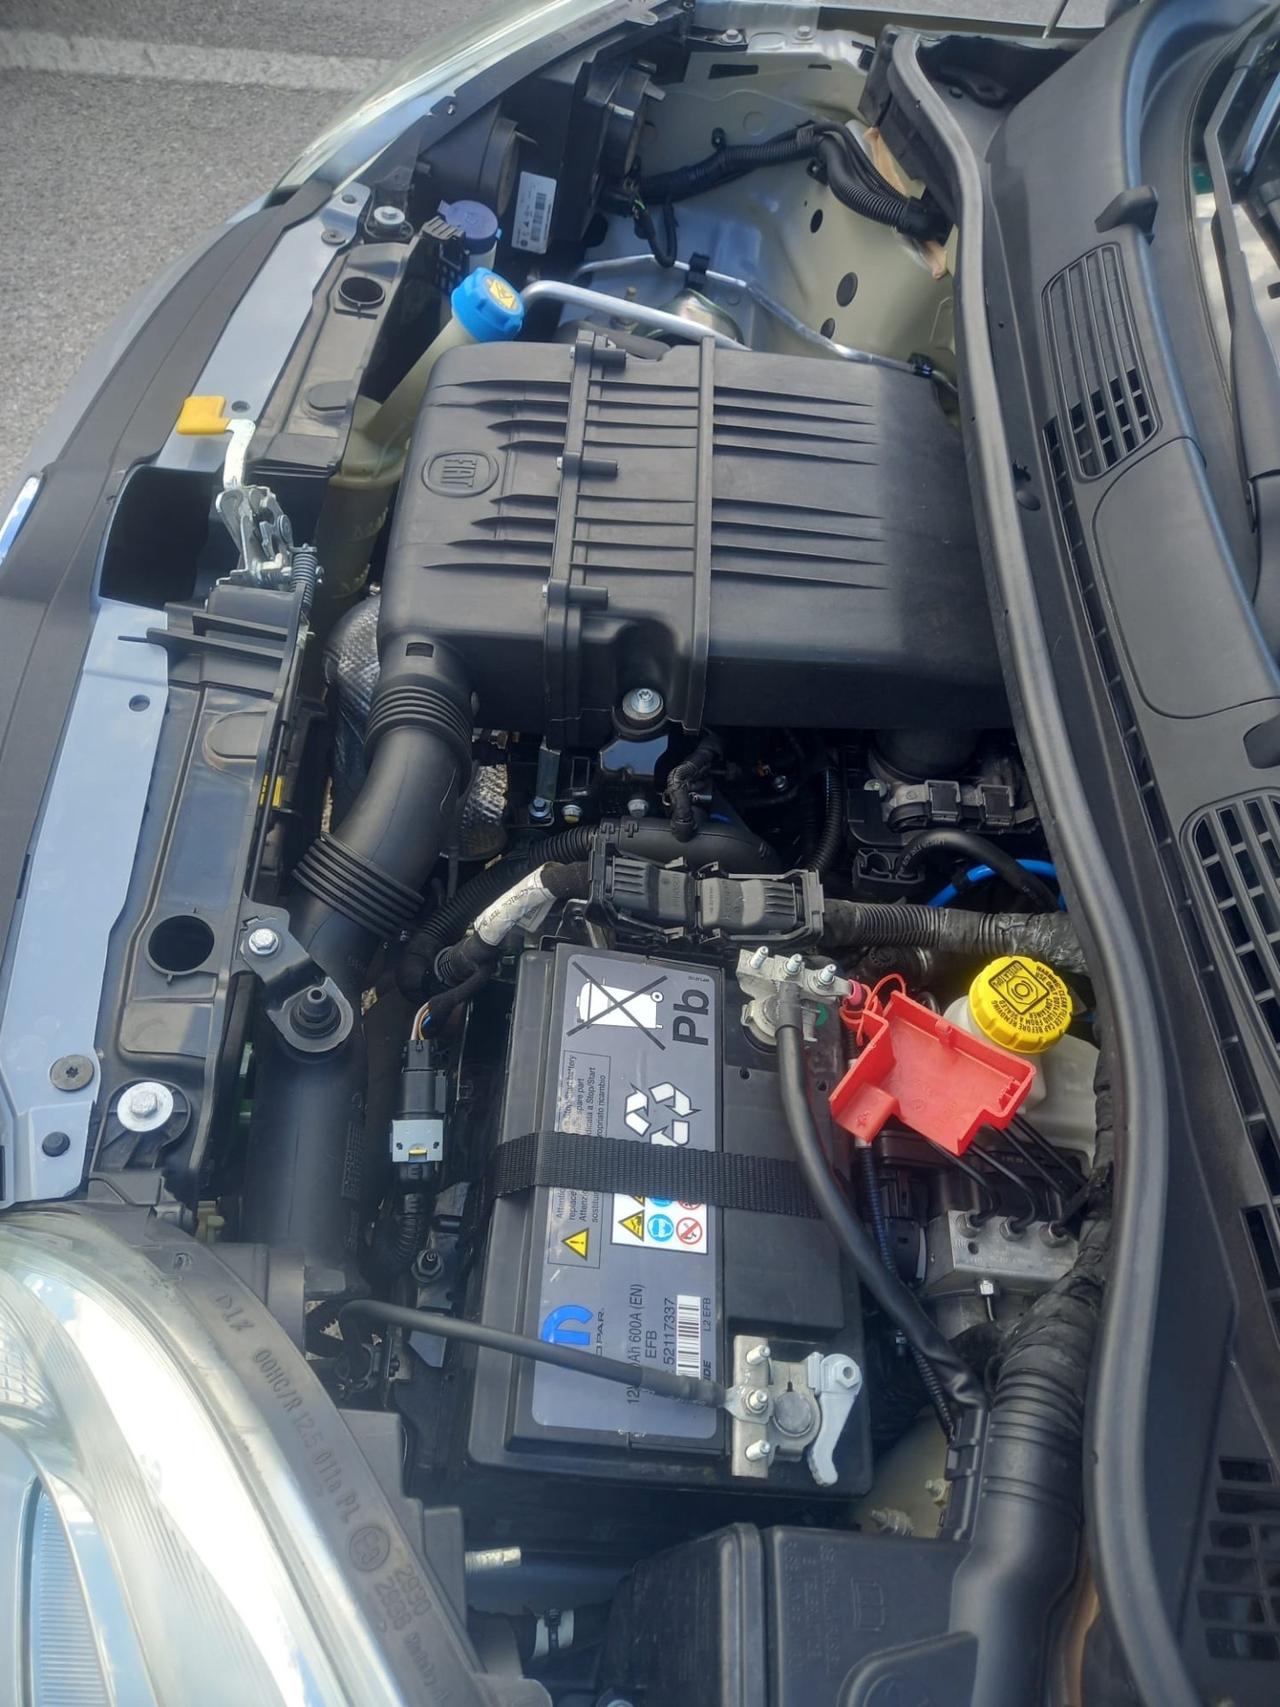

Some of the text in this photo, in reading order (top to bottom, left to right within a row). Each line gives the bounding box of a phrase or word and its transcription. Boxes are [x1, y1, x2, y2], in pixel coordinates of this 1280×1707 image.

[440, 459, 477, 488] FIAT
[672, 989, 709, 1046] Pb
[991, 1000, 1018, 1028] REMOVING
[1025, 1018, 1044, 1026] FROM
[1029, 998, 1053, 1019] CONTAINER
[1018, 1023, 1044, 1034] BEFORE
[1044, 1025, 1056, 1033] CAP
[577, 1078, 585, 1094] part
[586, 1067, 597, 1104] Stop/Start
[596, 1074, 607, 1137] ropriato ricambio
[569, 1190, 578, 1221] replace
[629, 1284, 646, 1310] (EN)
[595, 1311, 605, 1357] OPAR
[628, 1312, 642, 1343] 600A
[663, 1297, 676, 1366] 52117337
[703, 1296, 712, 1381] IDE L2 EFB
[645, 1330, 658, 1359] EFB
